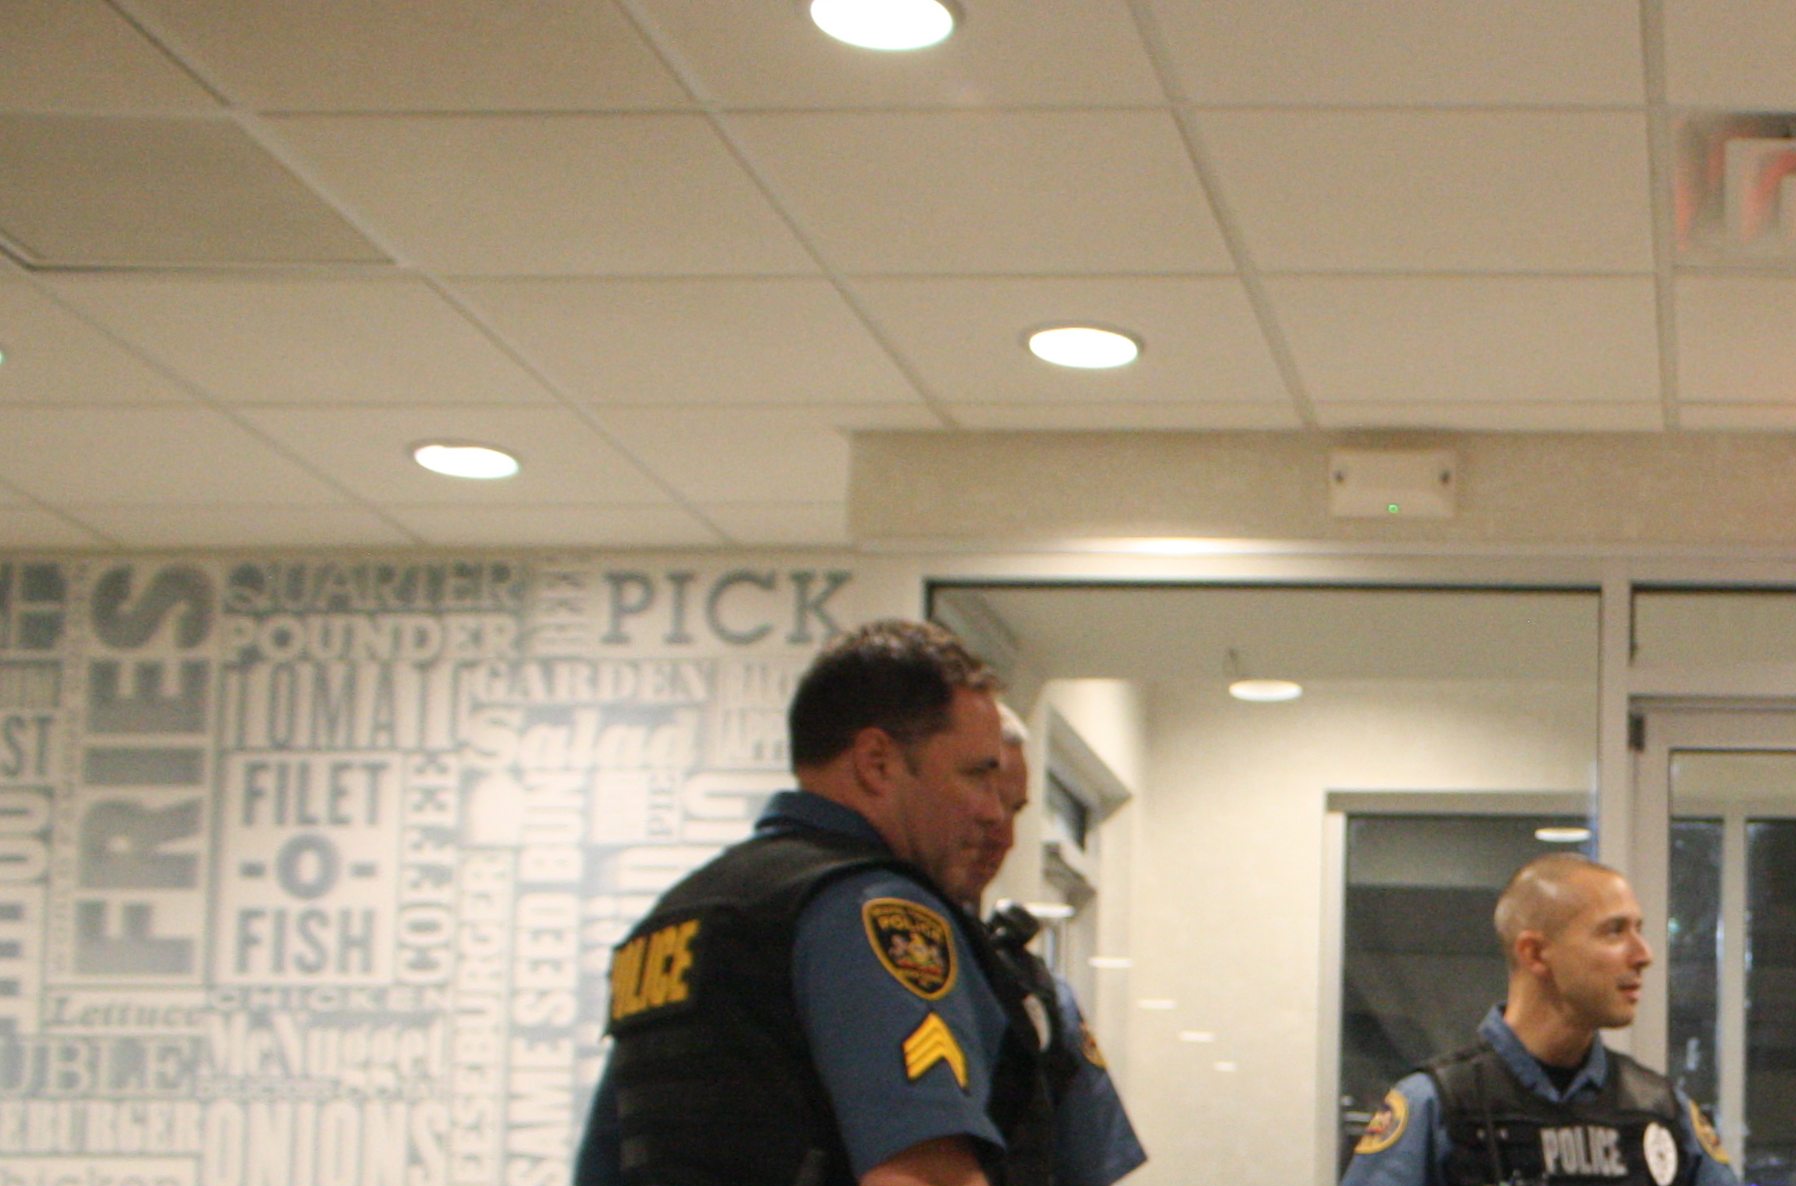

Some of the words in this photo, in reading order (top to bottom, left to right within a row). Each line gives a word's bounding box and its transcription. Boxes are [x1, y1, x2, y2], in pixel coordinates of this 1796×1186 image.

[222, 563, 524, 613] QUARTER
[601, 568, 853, 648] PICK
[221, 612, 521, 664] POUNDER
[470, 659, 712, 703] GARDEN
[75, 563, 213, 974] FRIES
[470, 704, 702, 772] Salad
[241, 760, 391, 828] FILET
[515, 769, 587, 884] BUN
[398, 752, 460, 986] COFFEE
[233, 906, 377, 976] FISH
[511, 893, 582, 1028] SEED
[45, 993, 208, 1030] Lettuce
[206, 985, 453, 1012] CHICKEN
[1540, 1125, 1629, 1178] POLICE
